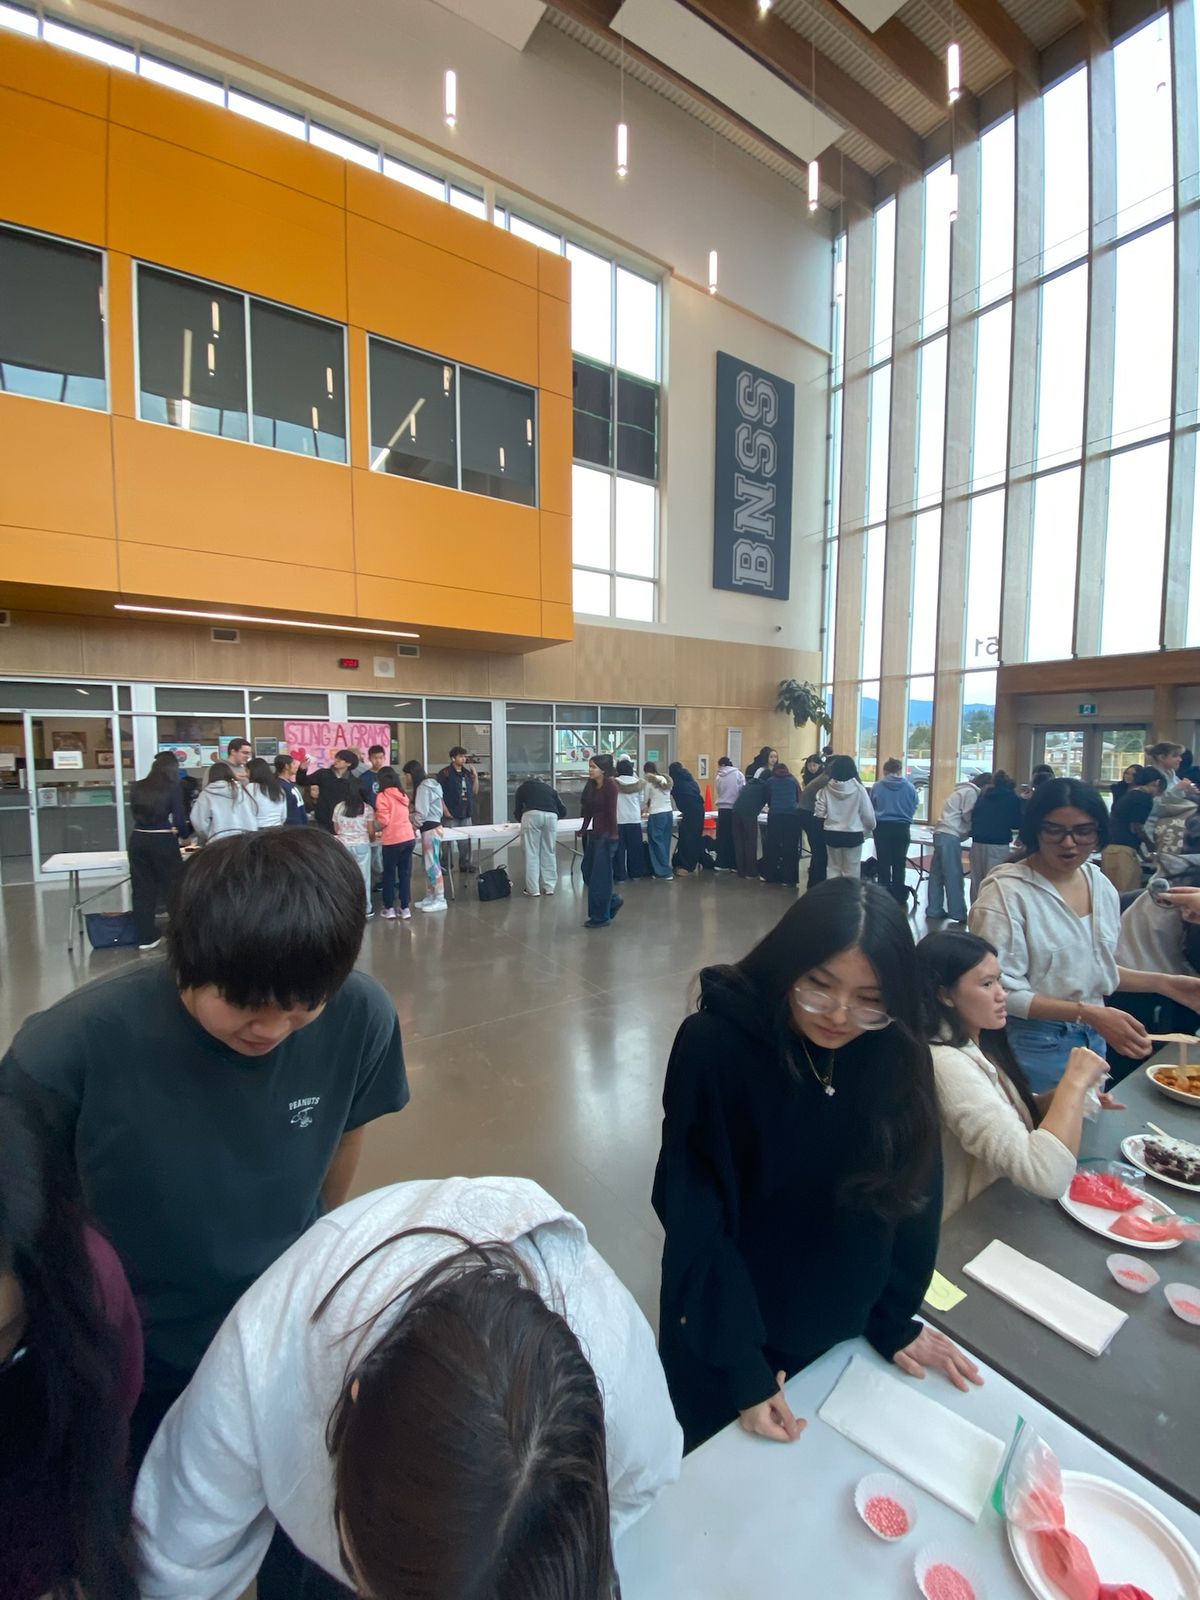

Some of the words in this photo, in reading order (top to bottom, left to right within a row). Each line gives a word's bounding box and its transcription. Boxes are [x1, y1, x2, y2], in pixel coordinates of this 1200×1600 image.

[732, 370, 779, 591] BNSS
[284, 722, 331, 746] SING
[334, 724, 348, 747] A
[350, 724, 391, 748] GRAMS
[288, 1096, 321, 1111] PEANUTS
